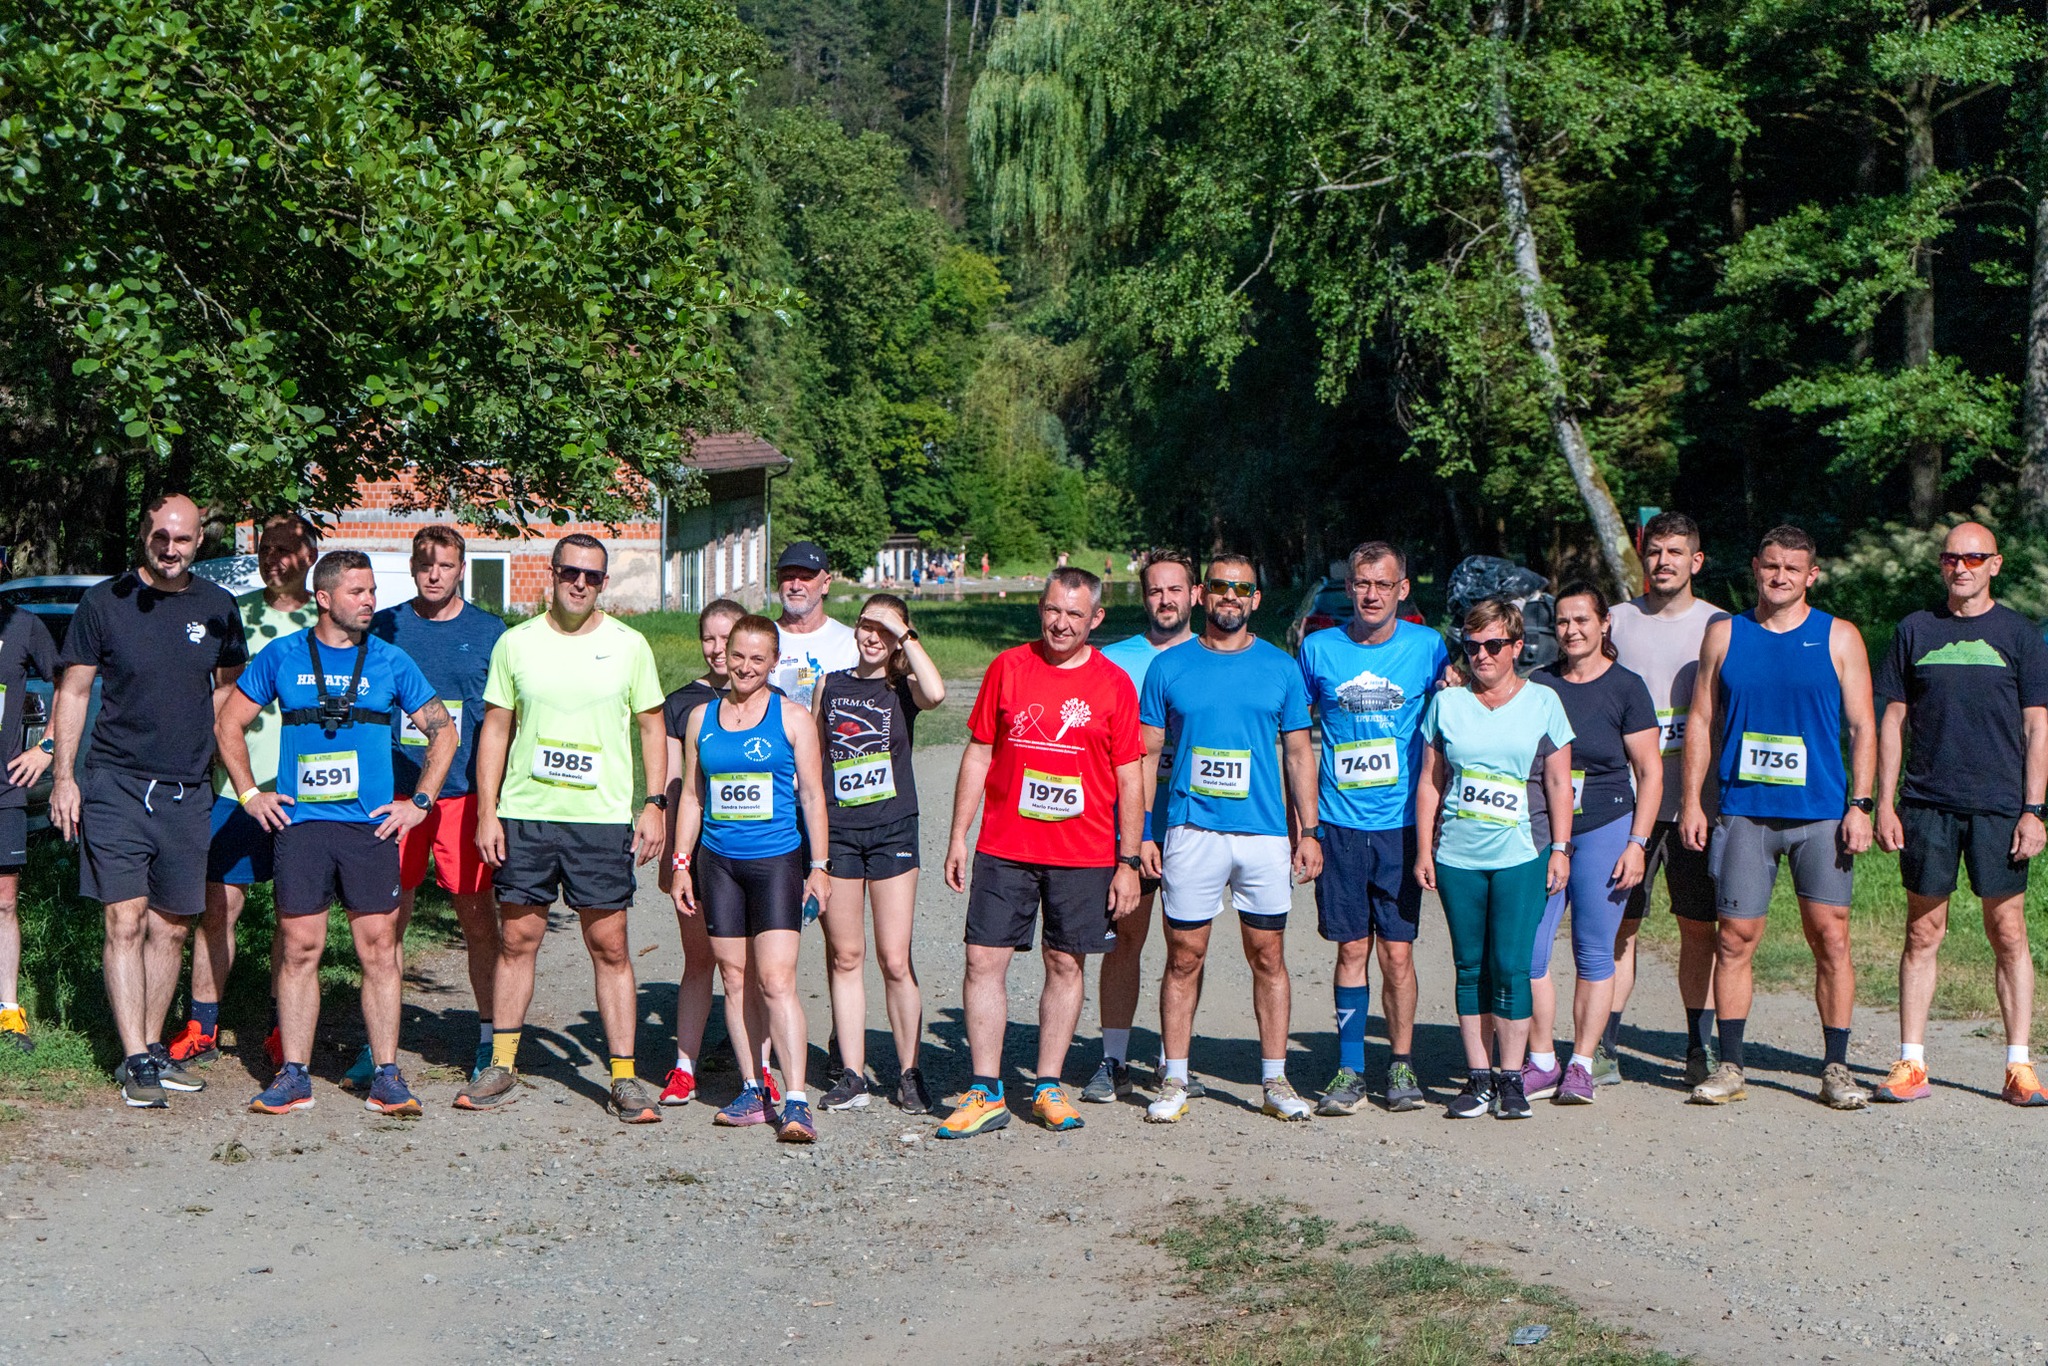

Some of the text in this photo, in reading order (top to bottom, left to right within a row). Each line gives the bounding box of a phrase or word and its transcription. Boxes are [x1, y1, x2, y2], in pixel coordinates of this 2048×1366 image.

[297, 674, 370, 688] HRATSA
[543, 750, 593, 773] 1985
[1200, 759, 1242, 779] 2511
[1341, 753, 1391, 774] 7401
[1750, 749, 1799, 770] 1736
[302, 767, 351, 787] 4591
[839, 767, 887, 792] 6247
[720, 785, 761, 801] 666
[1029, 782, 1077, 805] 1976
[1463, 785, 1518, 811] 8462
